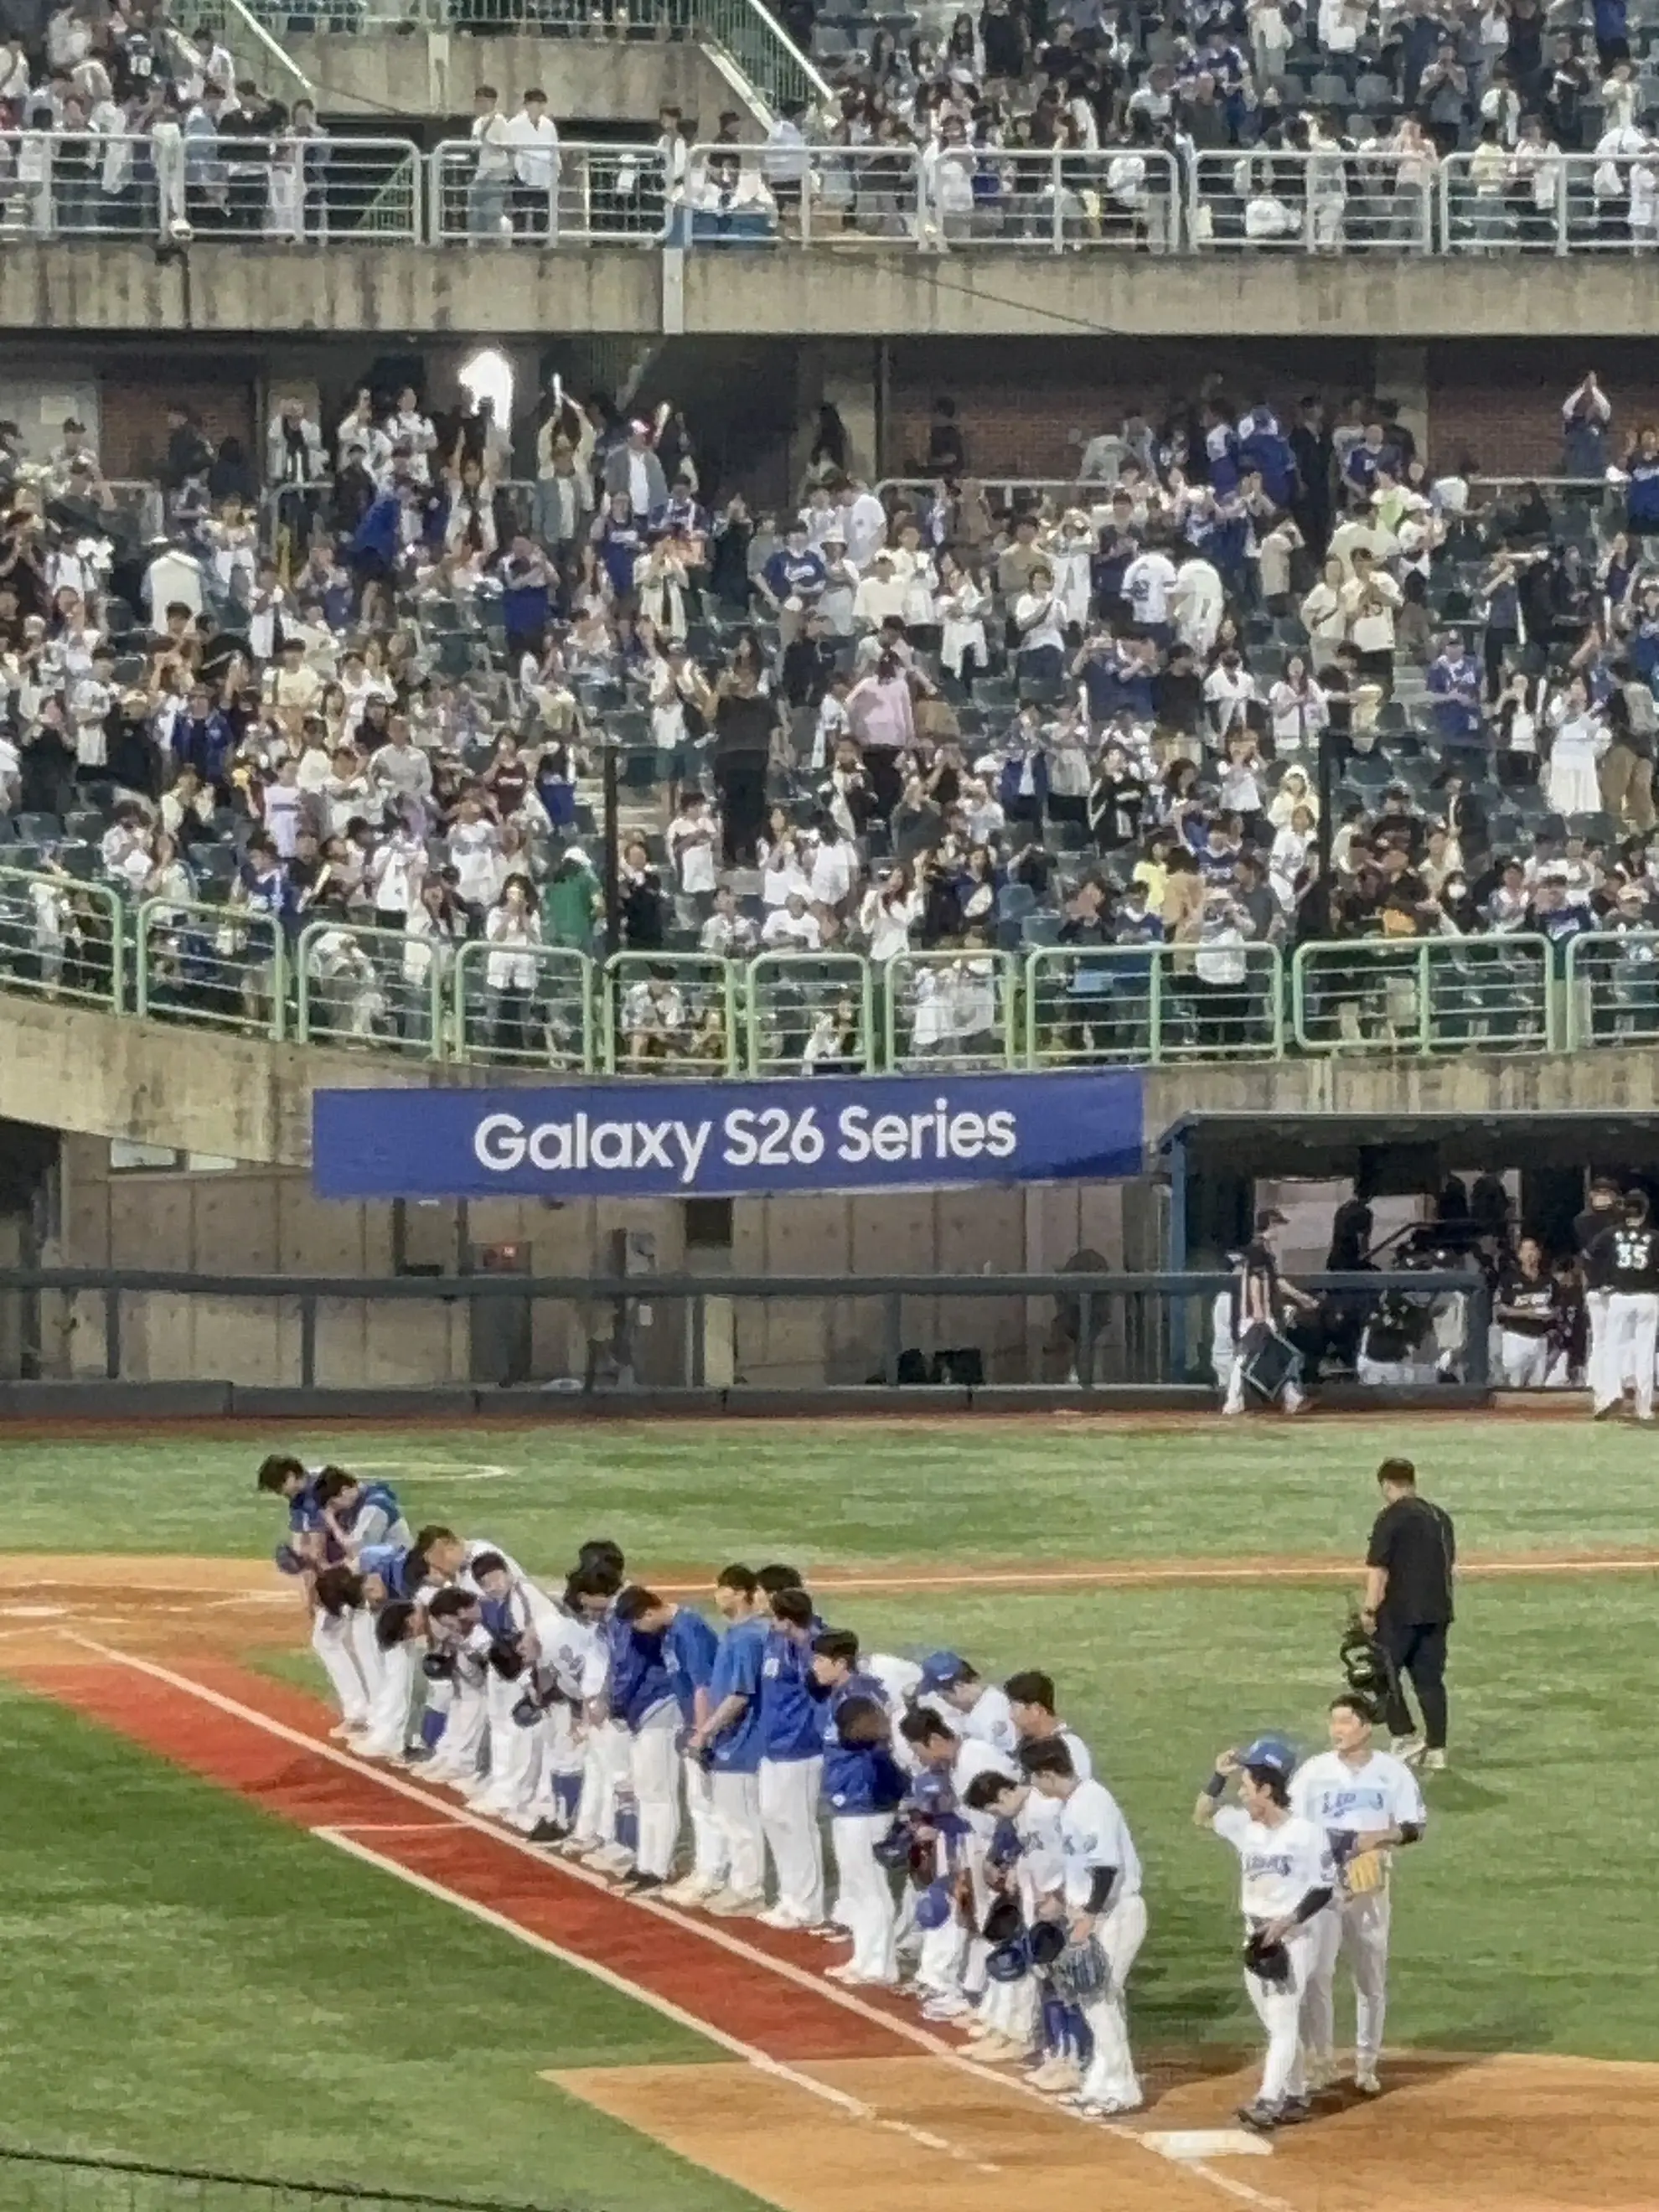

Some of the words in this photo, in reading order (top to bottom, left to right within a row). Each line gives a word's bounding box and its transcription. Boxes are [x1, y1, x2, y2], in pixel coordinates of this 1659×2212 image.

[473, 1111, 712, 1184] Galaxy
[722, 1106, 825, 1166] S26
[837, 1097, 1017, 1163] Series
